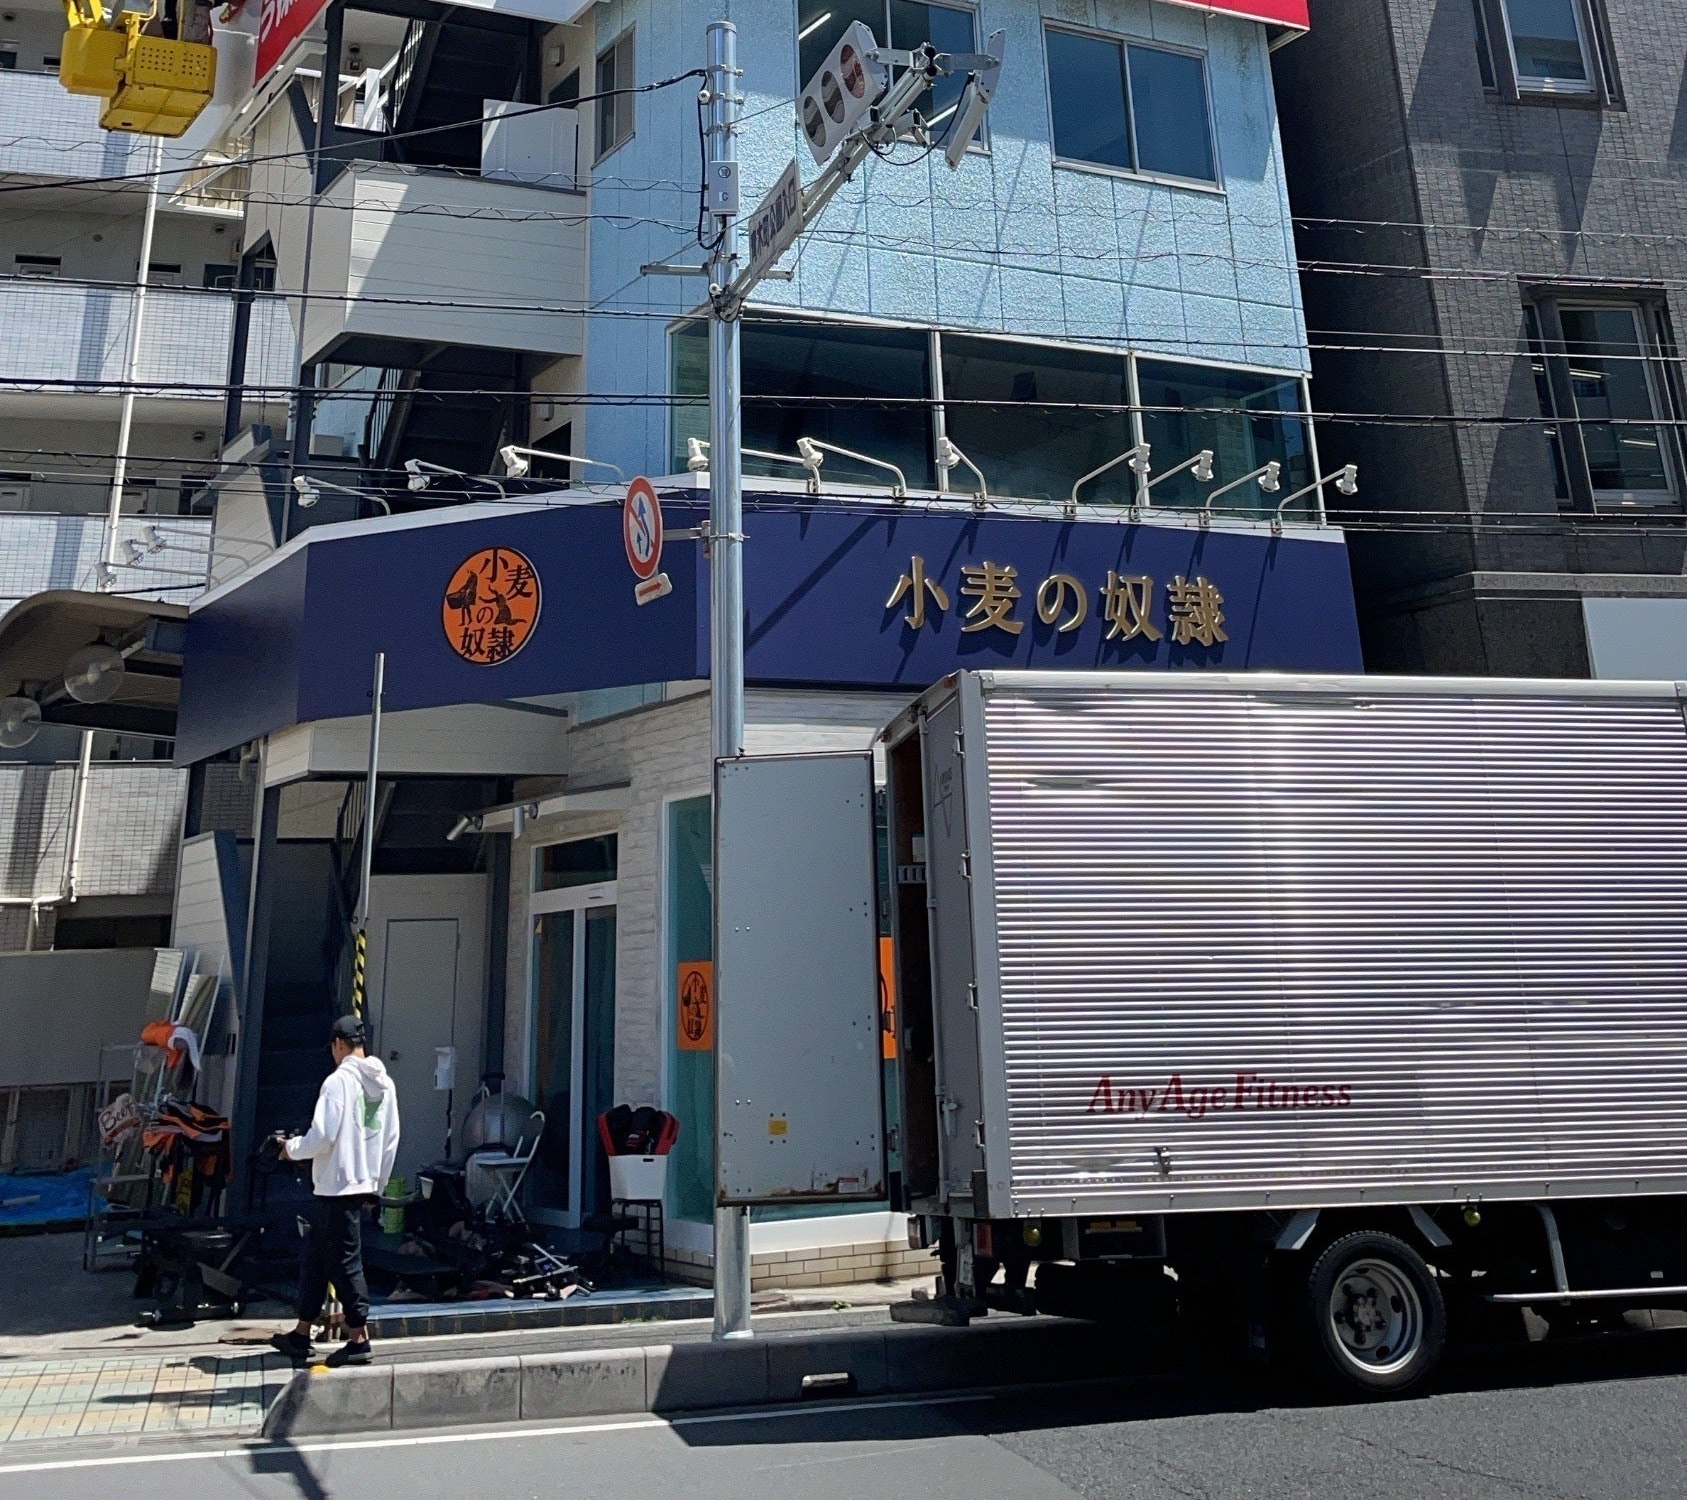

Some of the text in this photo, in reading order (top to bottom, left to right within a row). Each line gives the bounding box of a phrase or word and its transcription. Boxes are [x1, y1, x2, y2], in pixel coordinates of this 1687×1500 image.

[886, 555, 1229, 647] 小麦の奴隷
